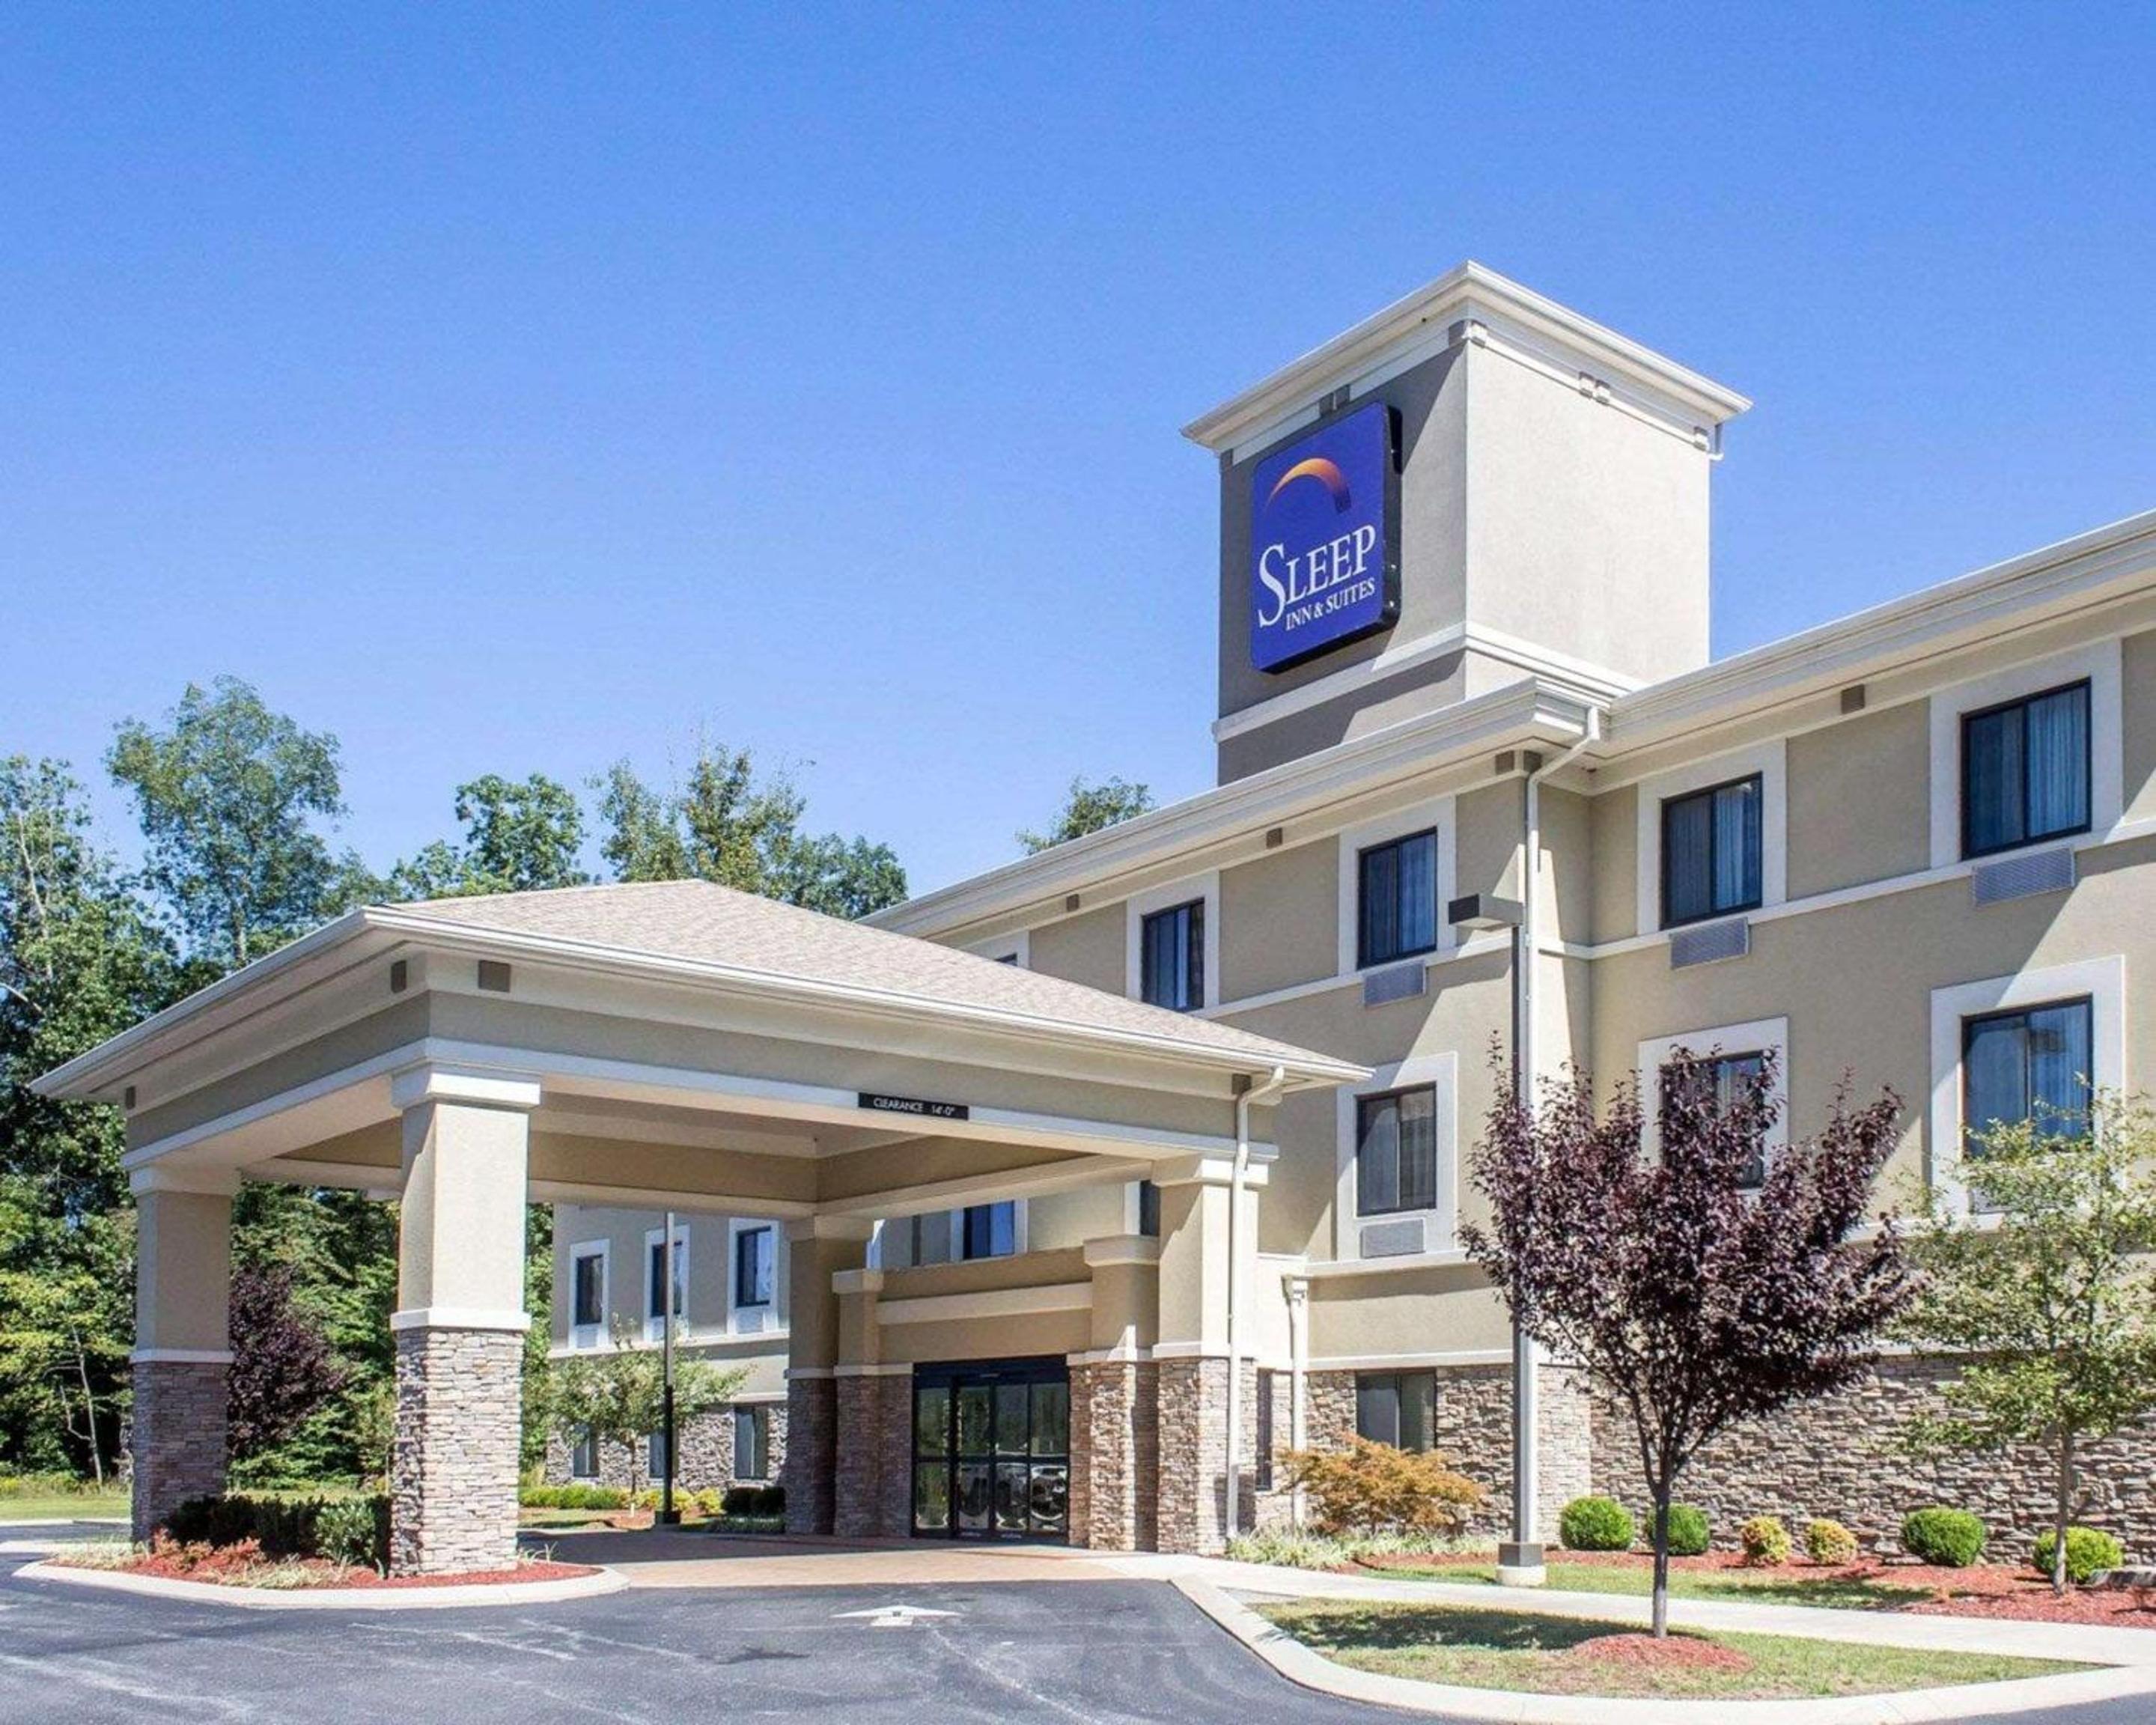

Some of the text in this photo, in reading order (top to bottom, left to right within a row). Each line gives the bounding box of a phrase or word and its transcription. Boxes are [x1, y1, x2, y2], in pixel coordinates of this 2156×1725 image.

[1258, 524, 1376, 627] SLEEP
[1285, 577, 1375, 630] INN & SUITES
[874, 1097, 924, 1112] CLEARANCE
